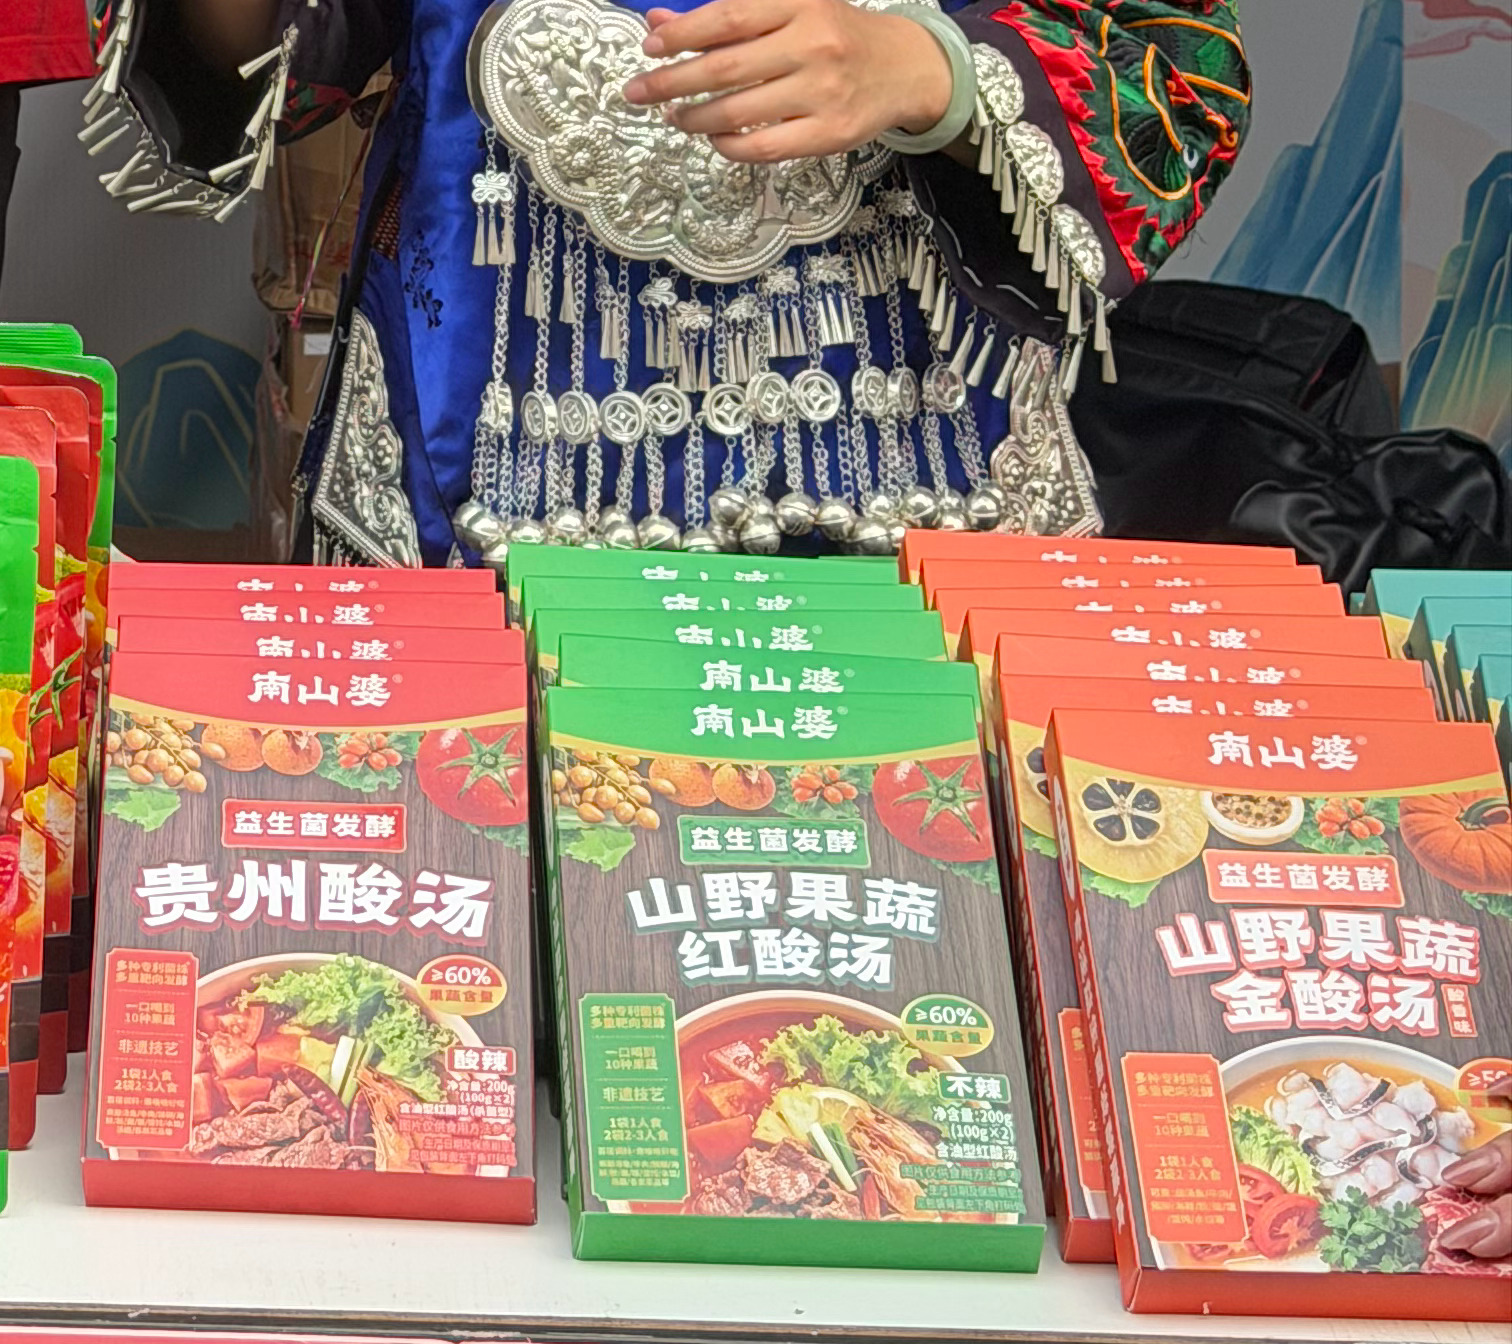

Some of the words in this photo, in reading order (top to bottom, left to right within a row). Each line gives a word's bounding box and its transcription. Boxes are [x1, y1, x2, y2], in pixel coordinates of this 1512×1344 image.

[247, 670, 392, 708] 南山婆
[690, 703, 838, 740] 南山婆
[1207, 730, 1359, 771] 南山婆
[232, 810, 397, 840] 益生菌发酵
[689, 818, 859, 856] 益生菌发酵
[1217, 862, 1390, 892] 益生菌发酵
[135, 858, 492, 940] 贵州酸汤
[627, 870, 941, 937] 山野果蔬
[678, 928, 896, 985] 红酸汤
[1158, 910, 1479, 978] 山野果蔬
[431, 965, 492, 986] ≥60%
[914, 1005, 977, 1026] ≥60%
[1213, 970, 1437, 1030] 金酸汤
[118, 1039, 179, 1056] 非遗技艺
[453, 1048, 508, 1072] 酸辣
[602, 1086, 665, 1103] 非遗技艺
[946, 1075, 1003, 1100] 不辣
